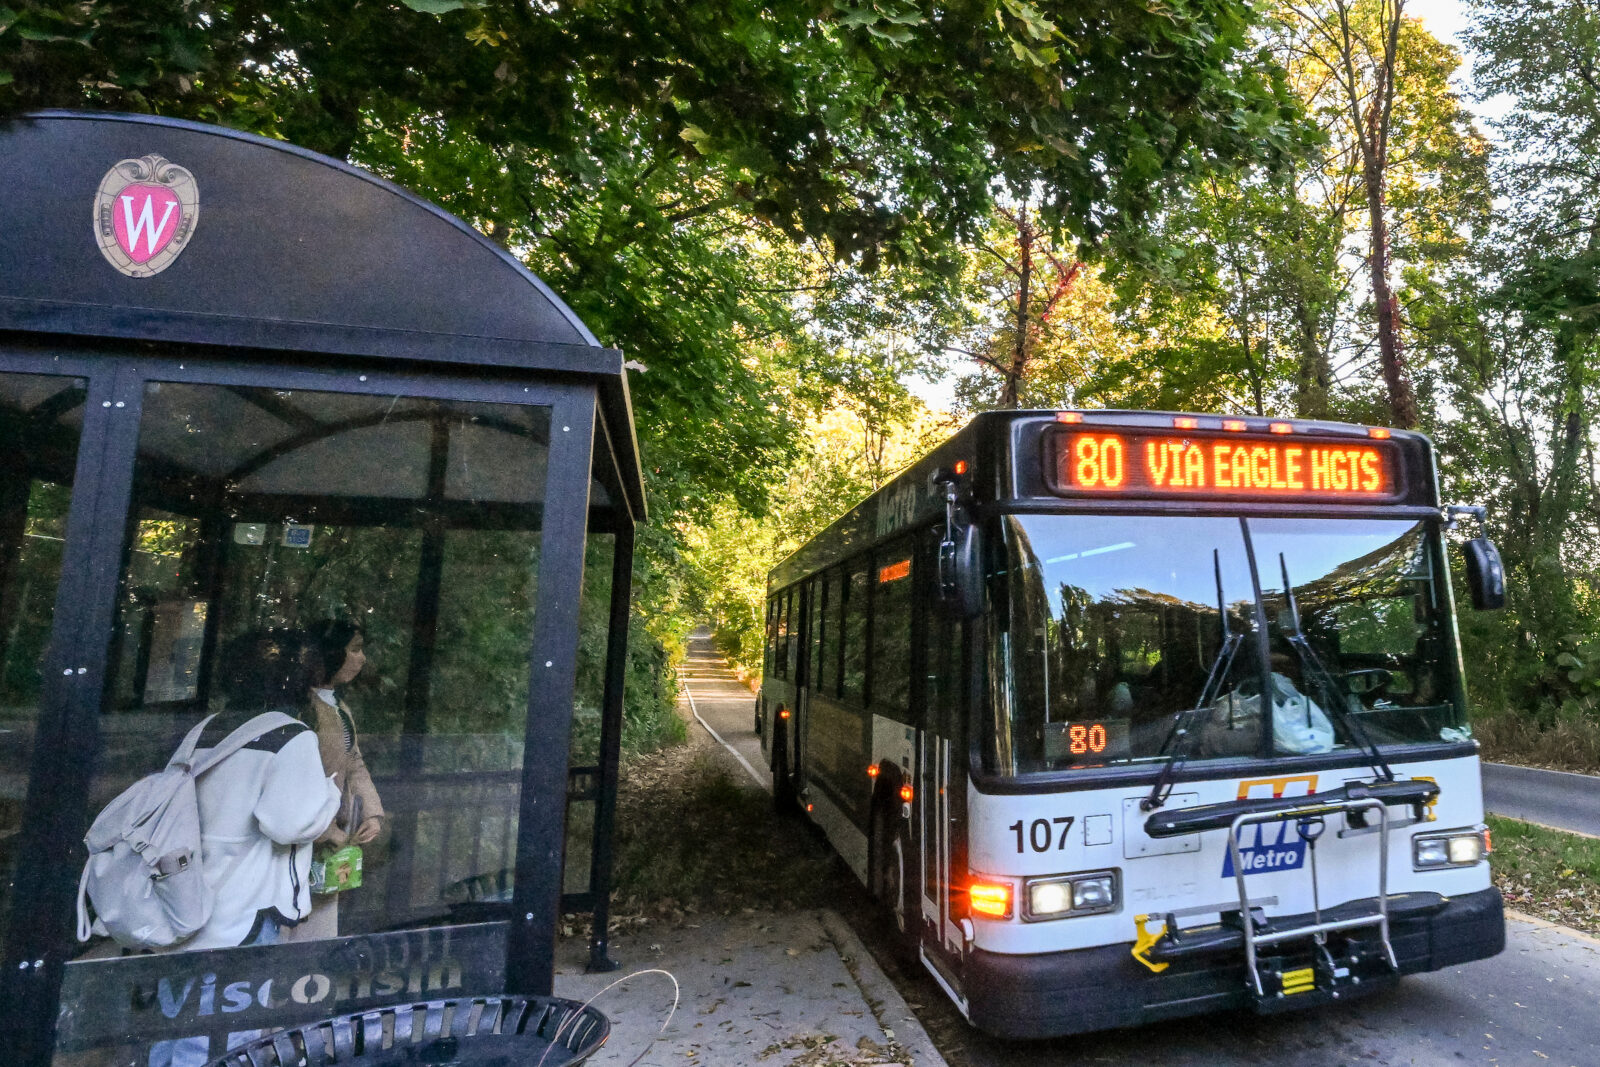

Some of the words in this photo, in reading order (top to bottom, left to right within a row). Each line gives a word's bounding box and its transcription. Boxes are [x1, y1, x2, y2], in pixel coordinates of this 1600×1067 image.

[121, 194, 178, 255] W
[1076, 437, 1123, 487] 80
[1147, 442, 1205, 487] VIA
[1213, 445, 1304, 489] EAGLE
[1311, 448, 1380, 491] HGTS
[1069, 724, 1107, 754] 80
[1009, 815, 1075, 854] 107
[1238, 849, 1298, 870] Metro
